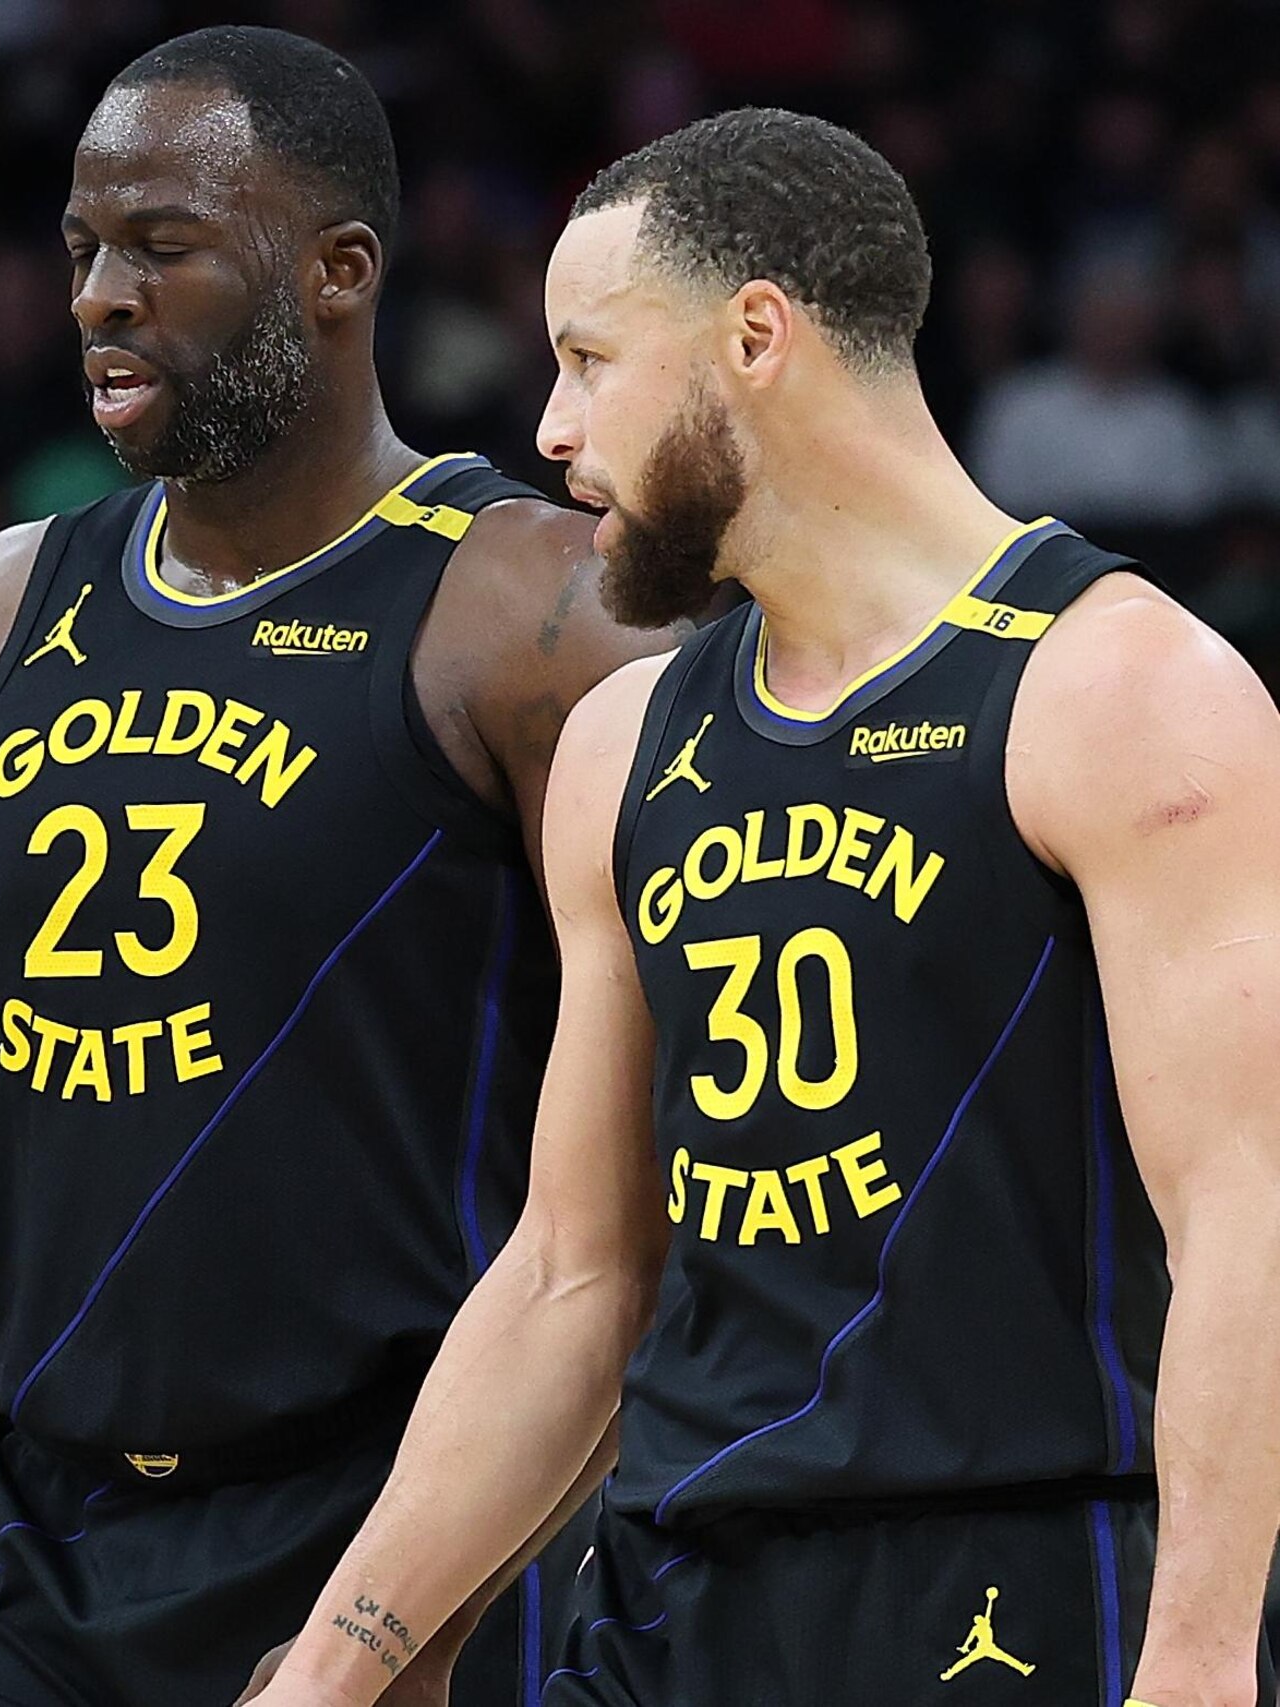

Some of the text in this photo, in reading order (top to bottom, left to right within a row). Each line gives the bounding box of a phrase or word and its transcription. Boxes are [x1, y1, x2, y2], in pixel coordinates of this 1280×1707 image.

[250, 618, 369, 656] Rakuten
[982, 607, 1017, 632] 16
[848, 720, 966, 763] Rakuten
[23, 802, 207, 979] 23
[638, 803, 945, 944] GOLDEN
[682, 927, 858, 1120] 30
[667, 1130, 903, 1246] STATE
